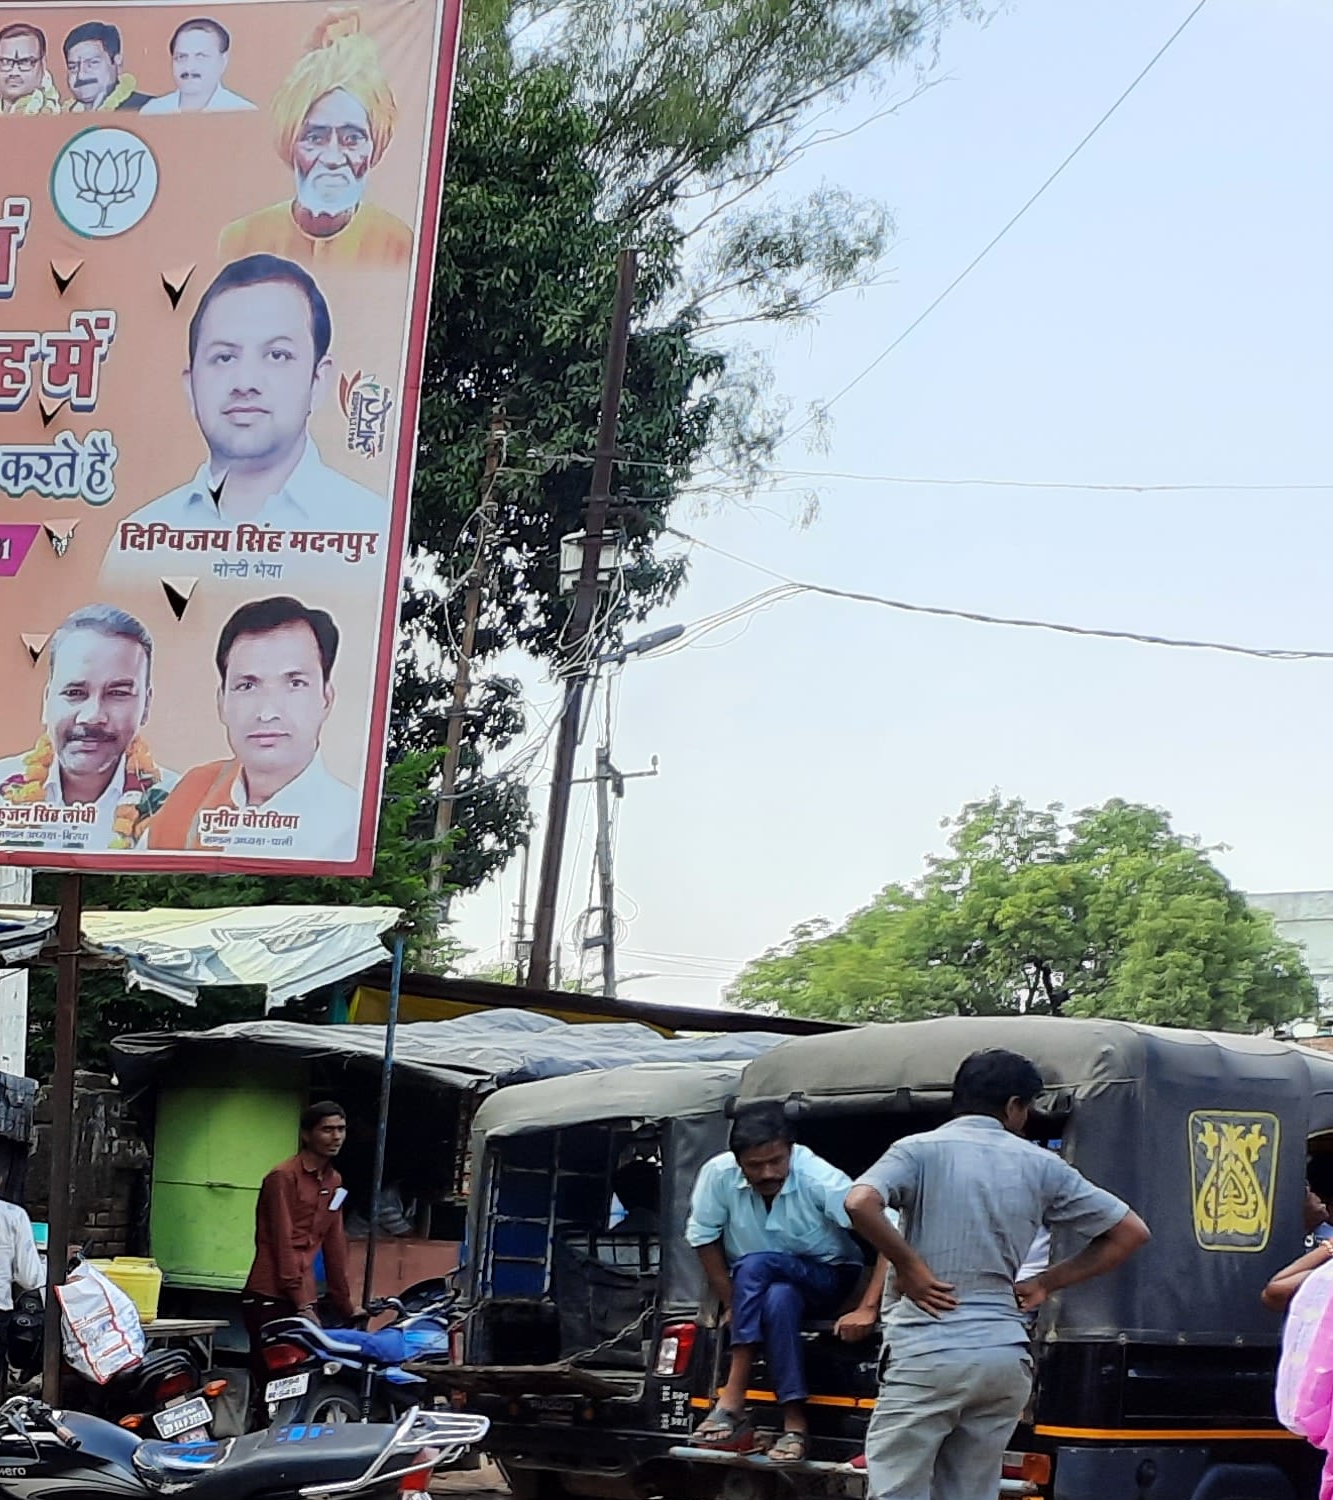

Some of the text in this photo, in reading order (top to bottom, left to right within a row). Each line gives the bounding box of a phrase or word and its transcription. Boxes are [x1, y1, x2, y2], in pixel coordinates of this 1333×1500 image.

[44, 315, 113, 400] में
[0, 436, 82, 490] करते
[119, 521, 380, 563] दिग्विजय सिंह मदनपुर
